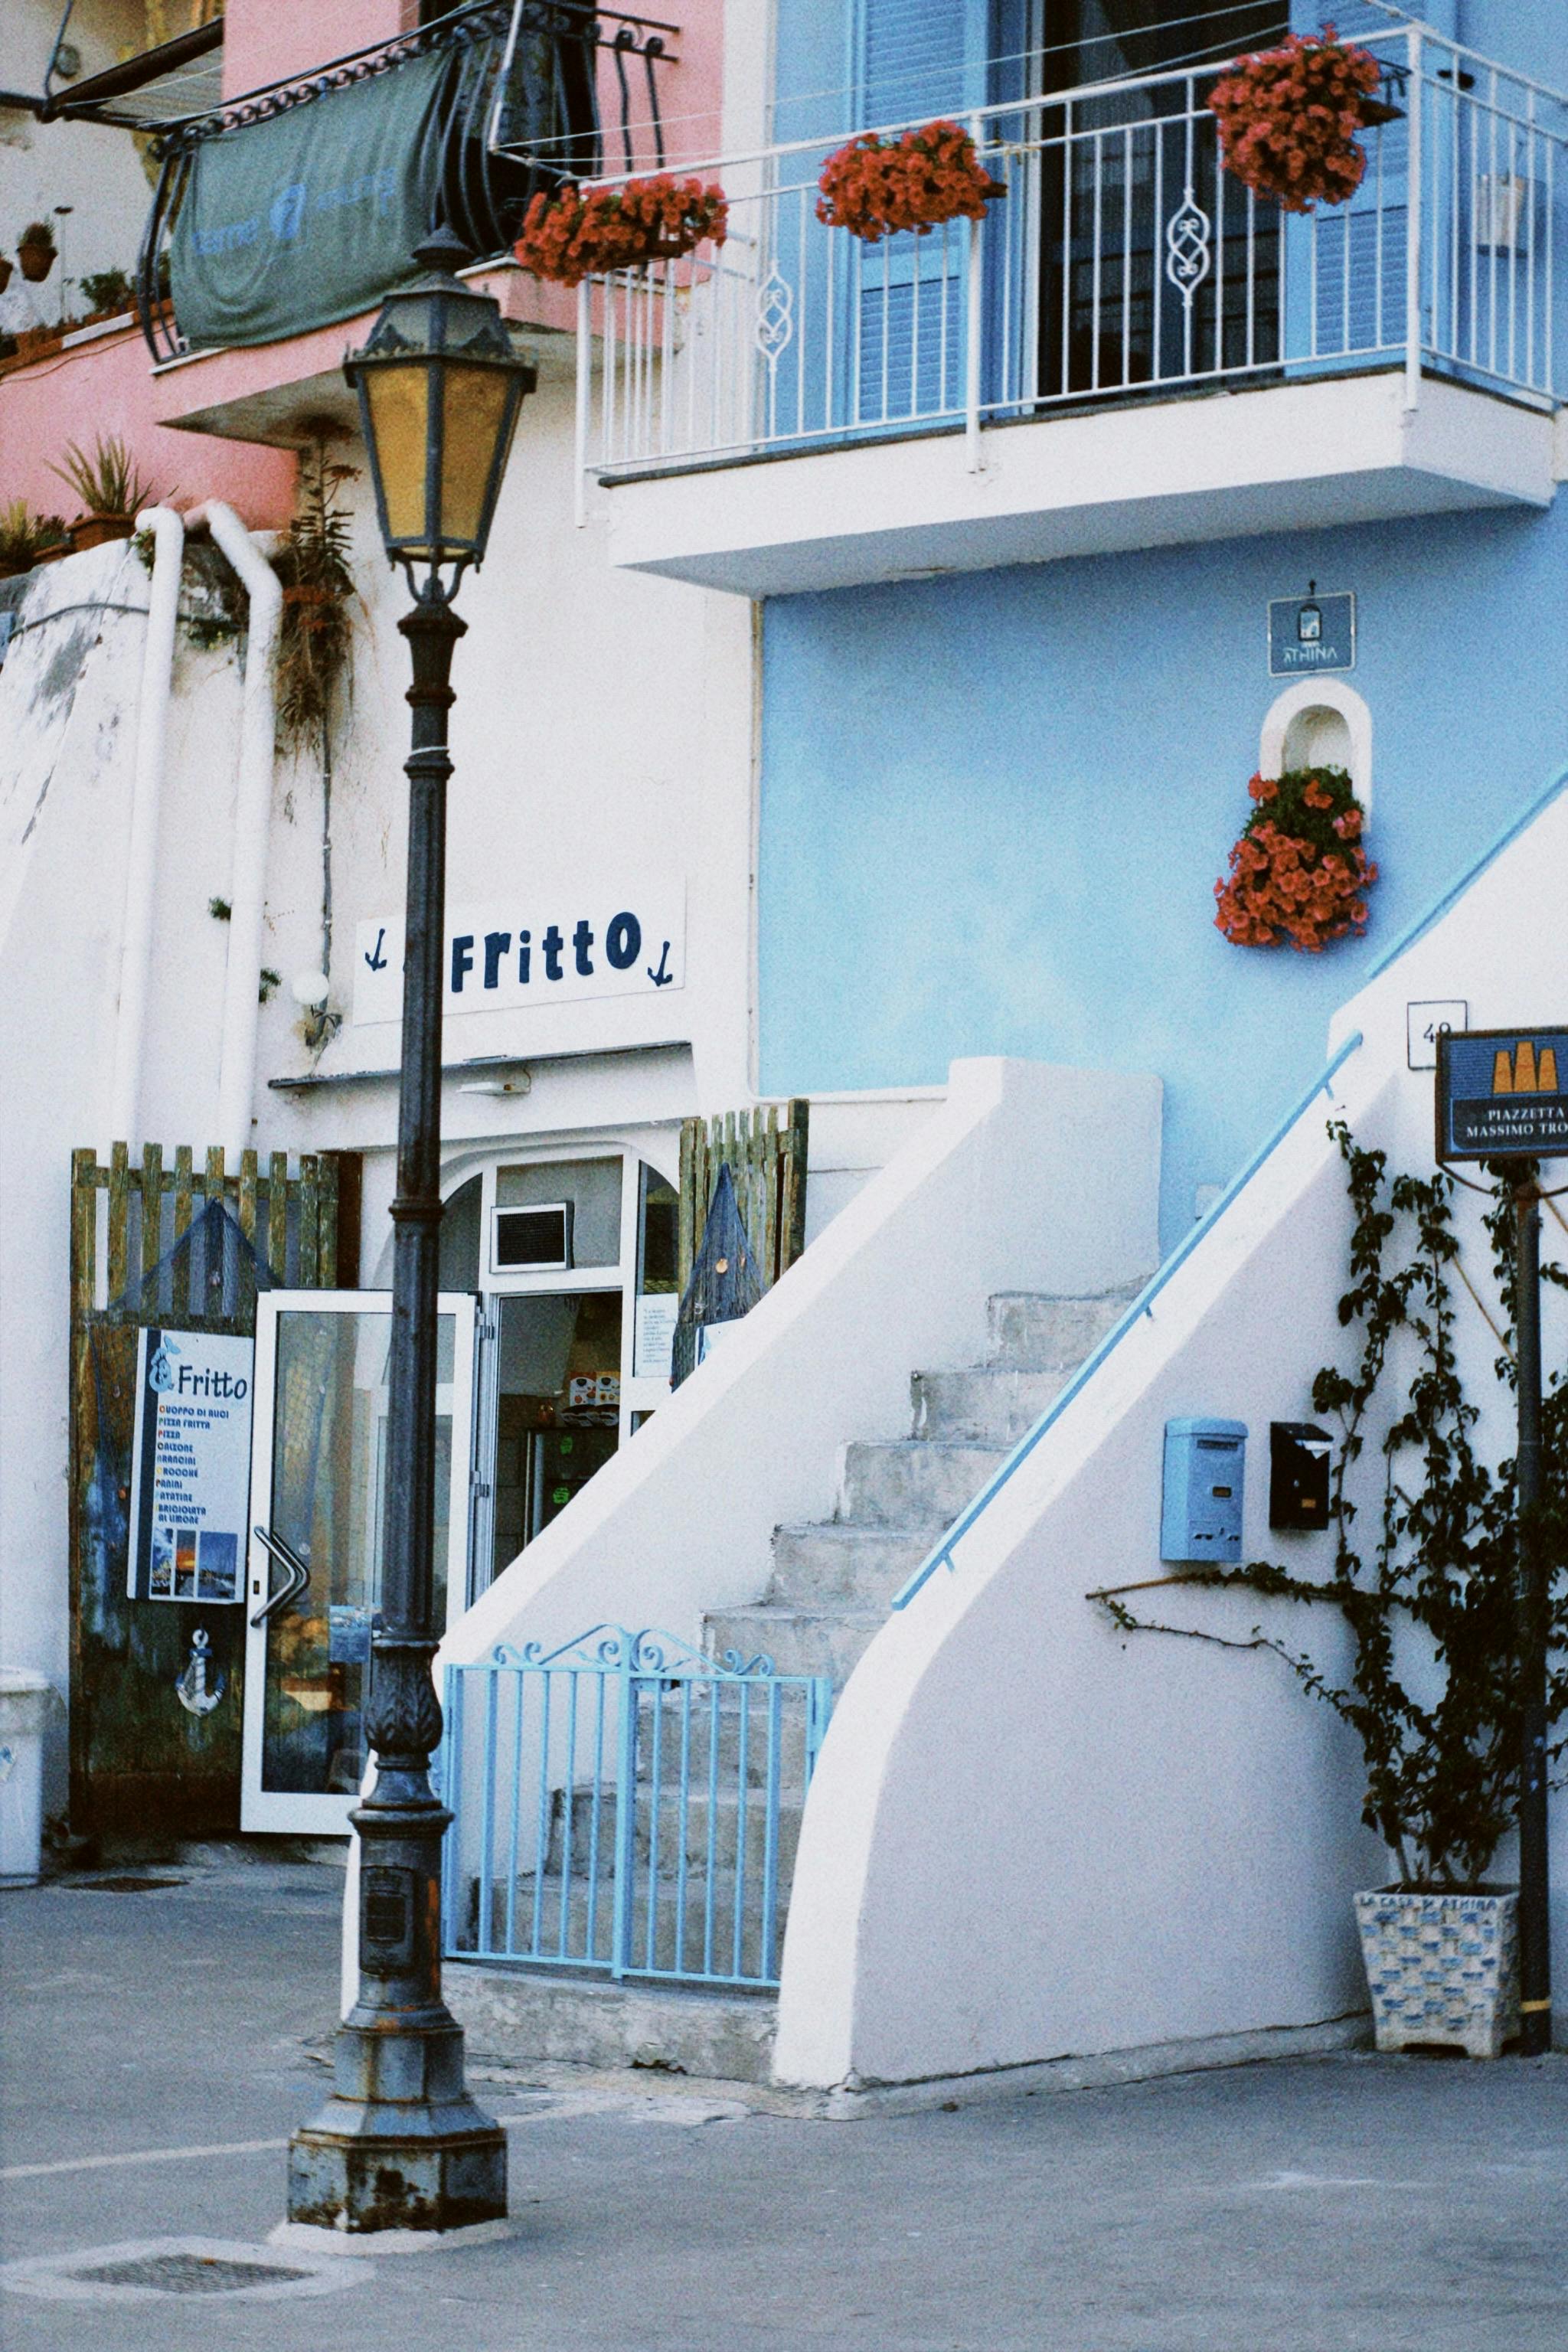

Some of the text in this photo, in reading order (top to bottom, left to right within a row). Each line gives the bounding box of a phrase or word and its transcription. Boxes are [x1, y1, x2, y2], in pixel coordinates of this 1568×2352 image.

[1488, 1106, 1565, 1122] PIAZZETTA
[1467, 1123, 1534, 1138] MASSIMO
[178, 1365, 247, 1400] Fritto
[159, 1405, 195, 1416] CUOPPO
[197, 1407, 206, 1417] DI
[158, 1417, 211, 1429] PIZZA FRITTA
[158, 1429, 181, 1439] PIZZA
[157, 1442, 194, 1453] CALZONE
[157, 1455, 196, 1465] ARANCINI
[155, 1478, 182, 1489] PANINI
[158, 1514, 199, 1524] AL LIMONE
